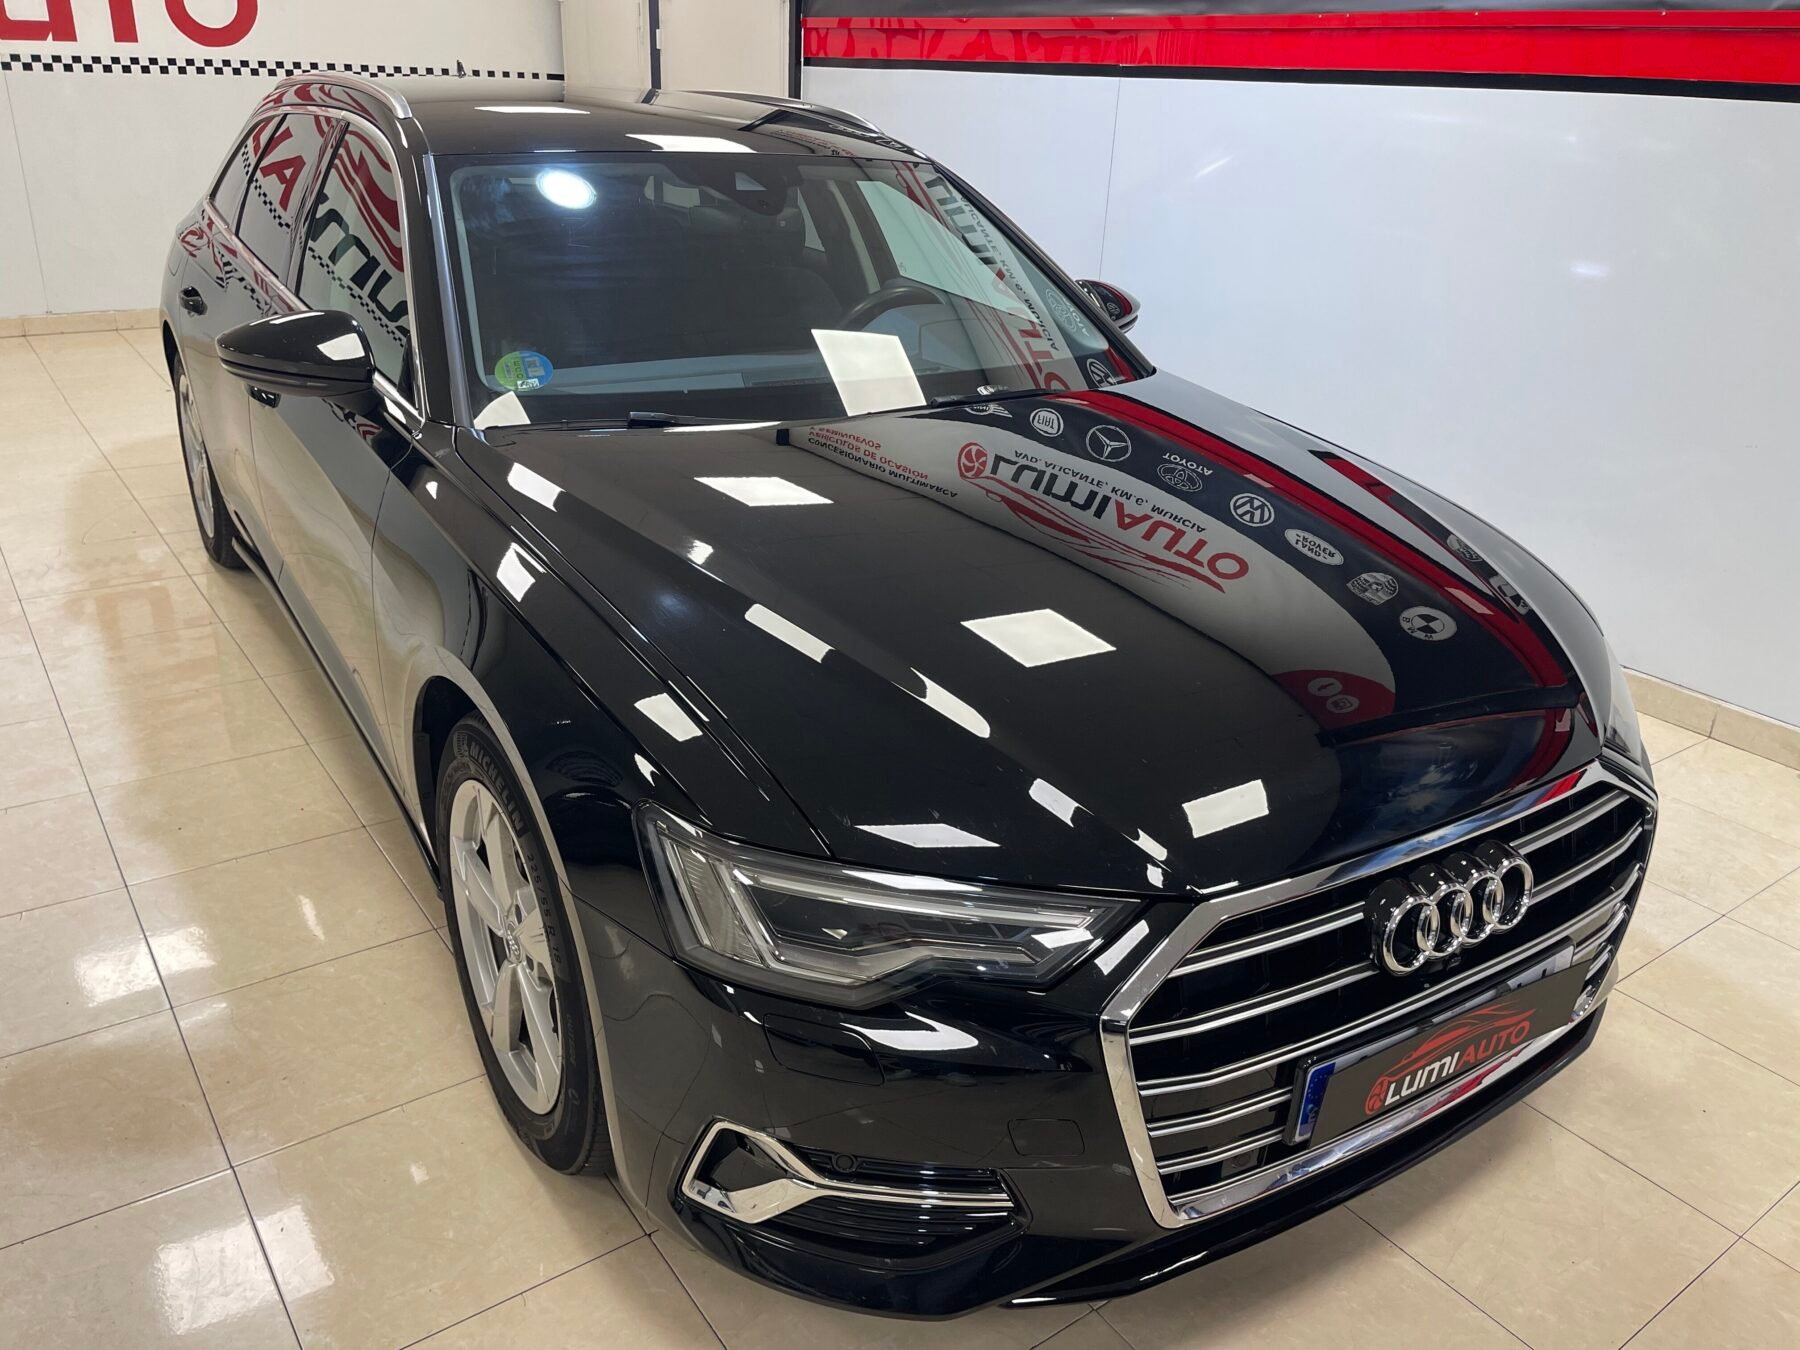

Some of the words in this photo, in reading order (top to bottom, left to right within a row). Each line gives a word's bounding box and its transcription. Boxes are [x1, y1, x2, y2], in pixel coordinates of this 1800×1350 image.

[469, 741, 526, 837] MICHELIN
[526, 854, 552, 918] 225/55
[547, 925, 556, 937] R
[552, 946, 562, 965] 18
